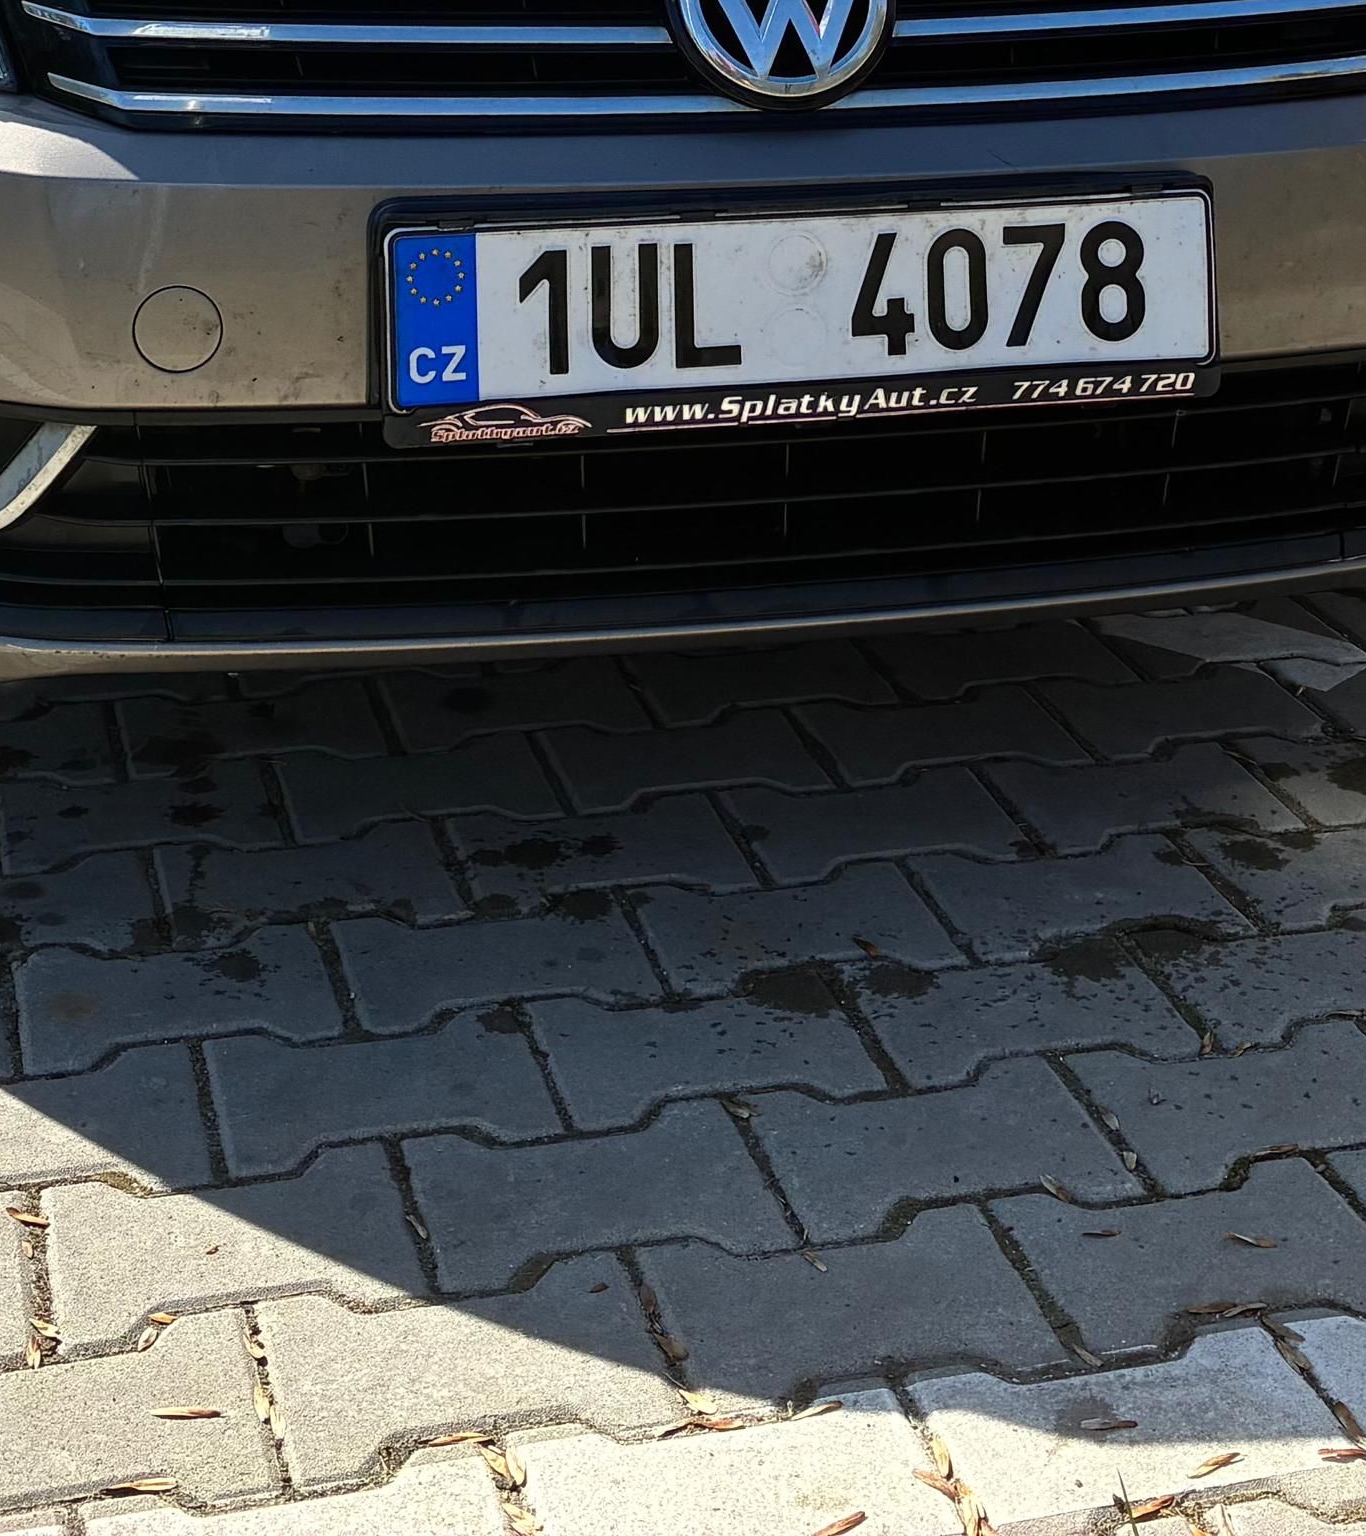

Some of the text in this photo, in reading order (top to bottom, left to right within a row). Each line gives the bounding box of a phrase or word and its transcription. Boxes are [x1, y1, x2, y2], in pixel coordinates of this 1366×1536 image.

[519, 220, 1146, 376] 1UL 4078
[409, 345, 468, 384] CZ
[625, 372, 1195, 424] www.SplatkyAut.cz 774 674 720
